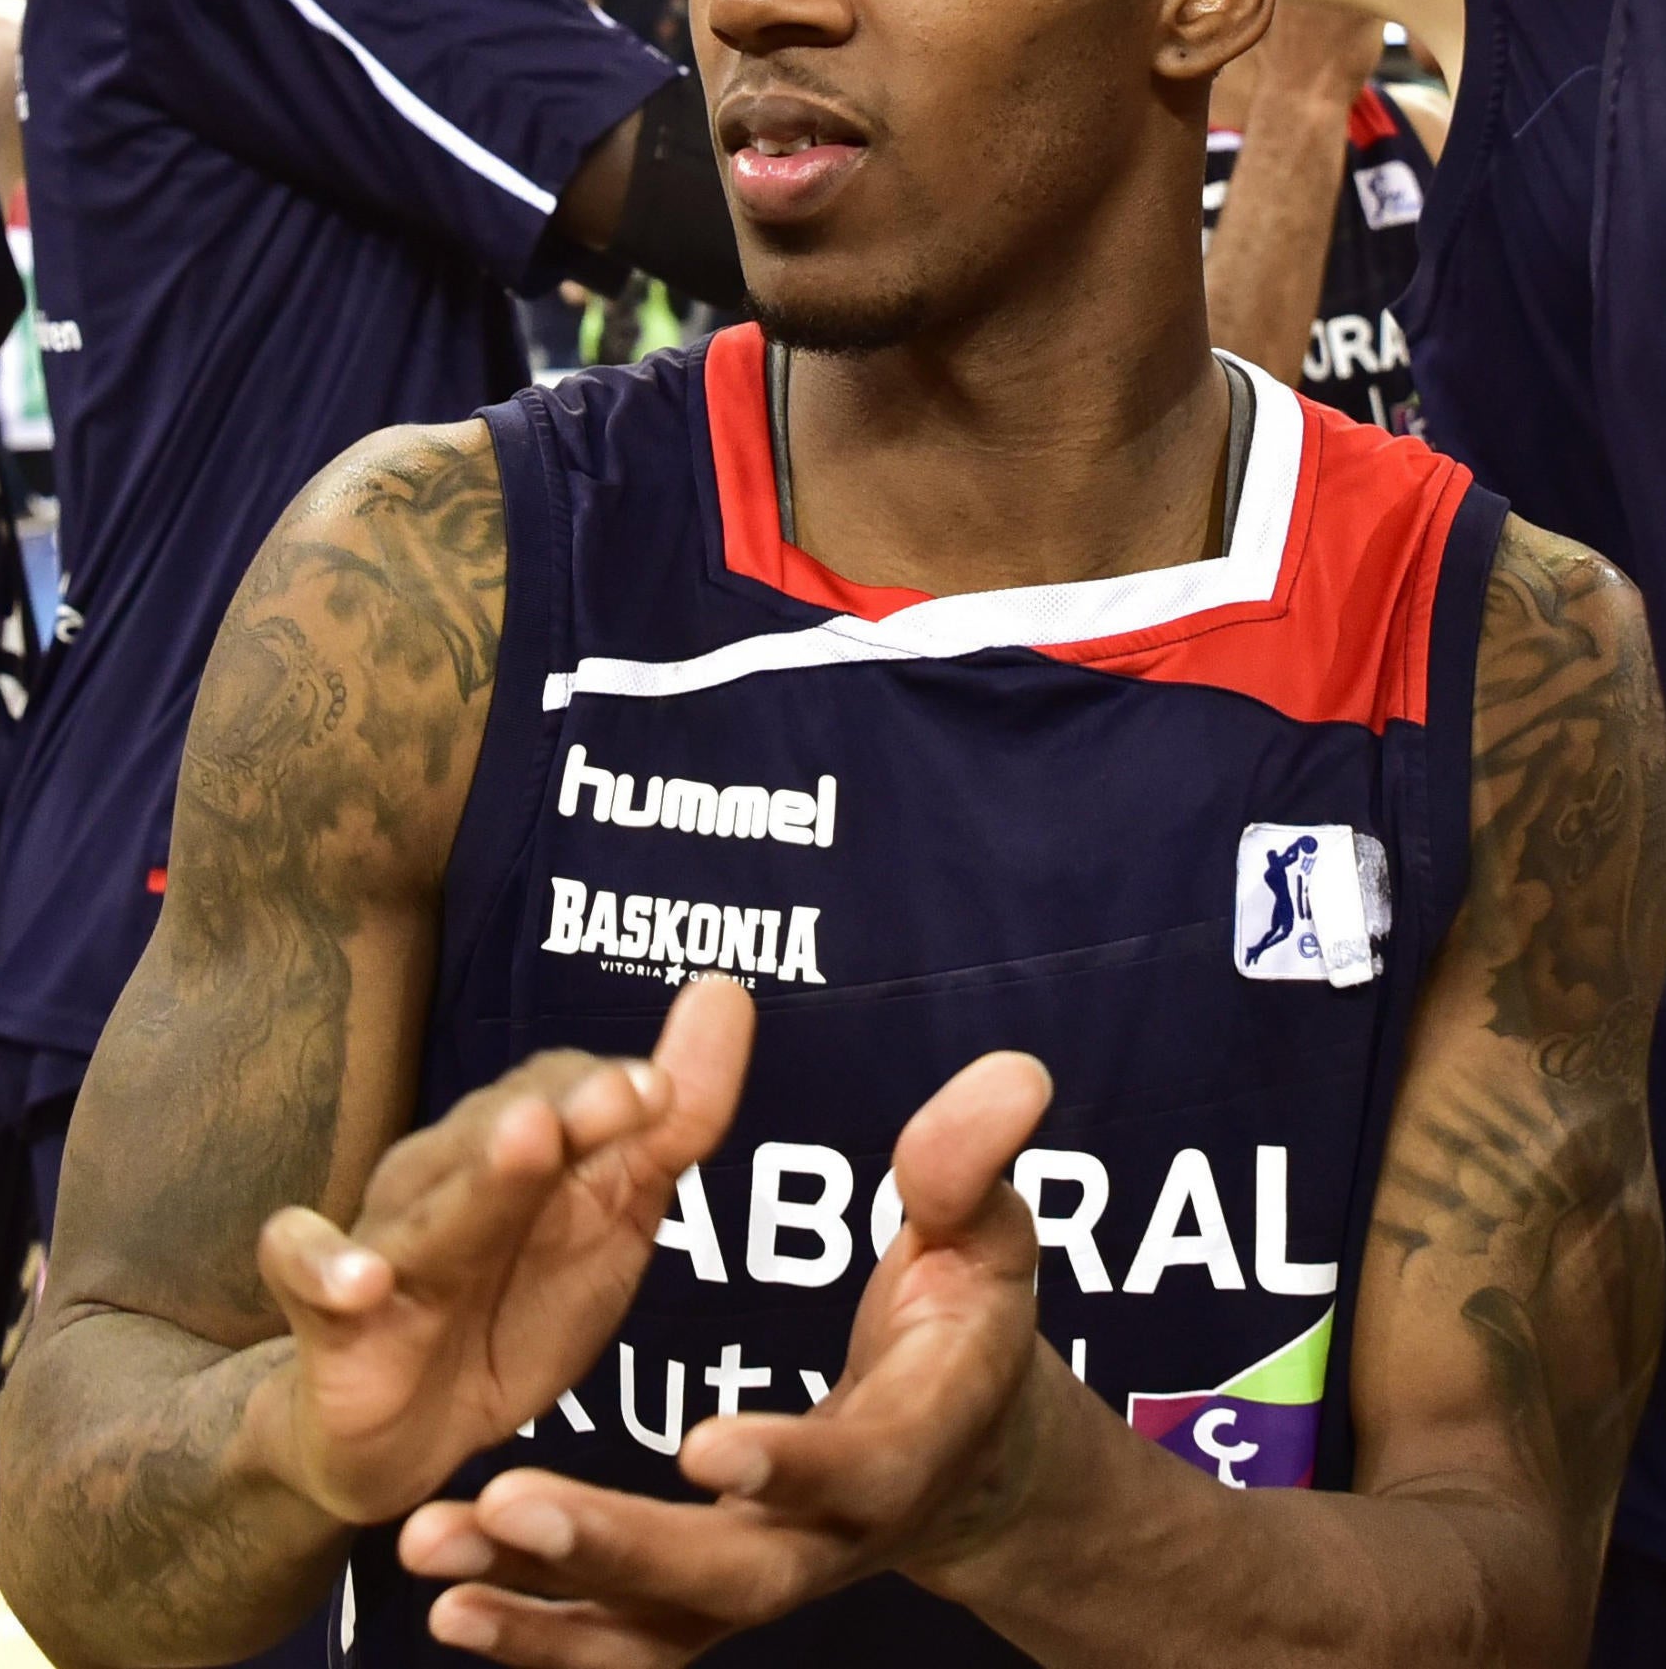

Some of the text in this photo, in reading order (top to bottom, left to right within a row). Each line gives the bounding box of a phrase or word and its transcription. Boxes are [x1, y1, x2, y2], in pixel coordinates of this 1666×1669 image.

[557, 743, 837, 848] hummel
[540, 876, 827, 984] BASKONIA
[599, 960, 662, 979] VITORIA
[654, 1140, 1338, 1296] ABRAL
